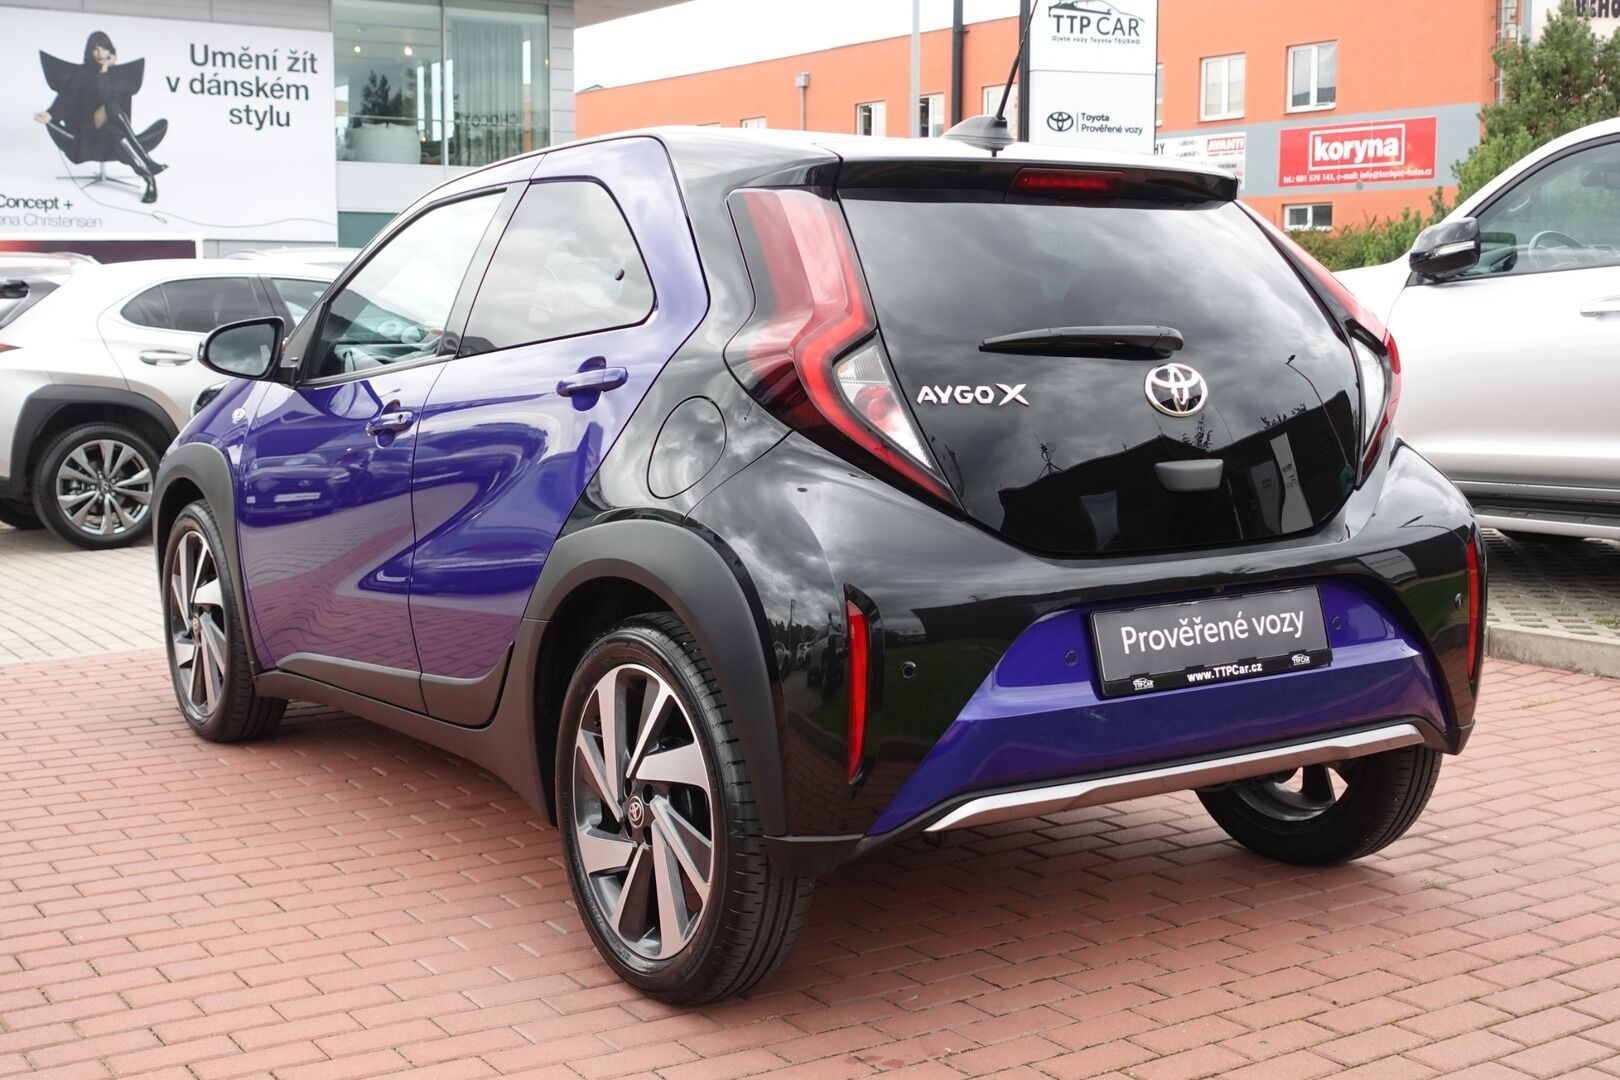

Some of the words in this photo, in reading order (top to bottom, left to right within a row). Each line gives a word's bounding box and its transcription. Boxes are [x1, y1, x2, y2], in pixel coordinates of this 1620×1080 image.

[1052, 14, 1091, 34] TTP
[1096, 16, 1140, 37] CAR
[1090, 36, 1112, 44] Toyota
[190, 43, 279, 71] Umění
[286, 48, 319, 74] žít
[166, 76, 180, 93] v
[189, 73, 310, 101] dánském
[228, 105, 291, 131] stylu
[1081, 112, 1110, 124] Toyota
[1081, 123, 1123, 134] Prověřené
[1125, 126, 1144, 136] vozy
[1313, 135, 1400, 164] koryna
[0, 193, 60, 213] Concept
[23, 212, 103, 228] Christensen
[1120, 611, 1249, 654] Prověřené
[1251, 610, 1304, 638] vozy
[1187, 663, 1263, 683] www.TTPCar.cz
